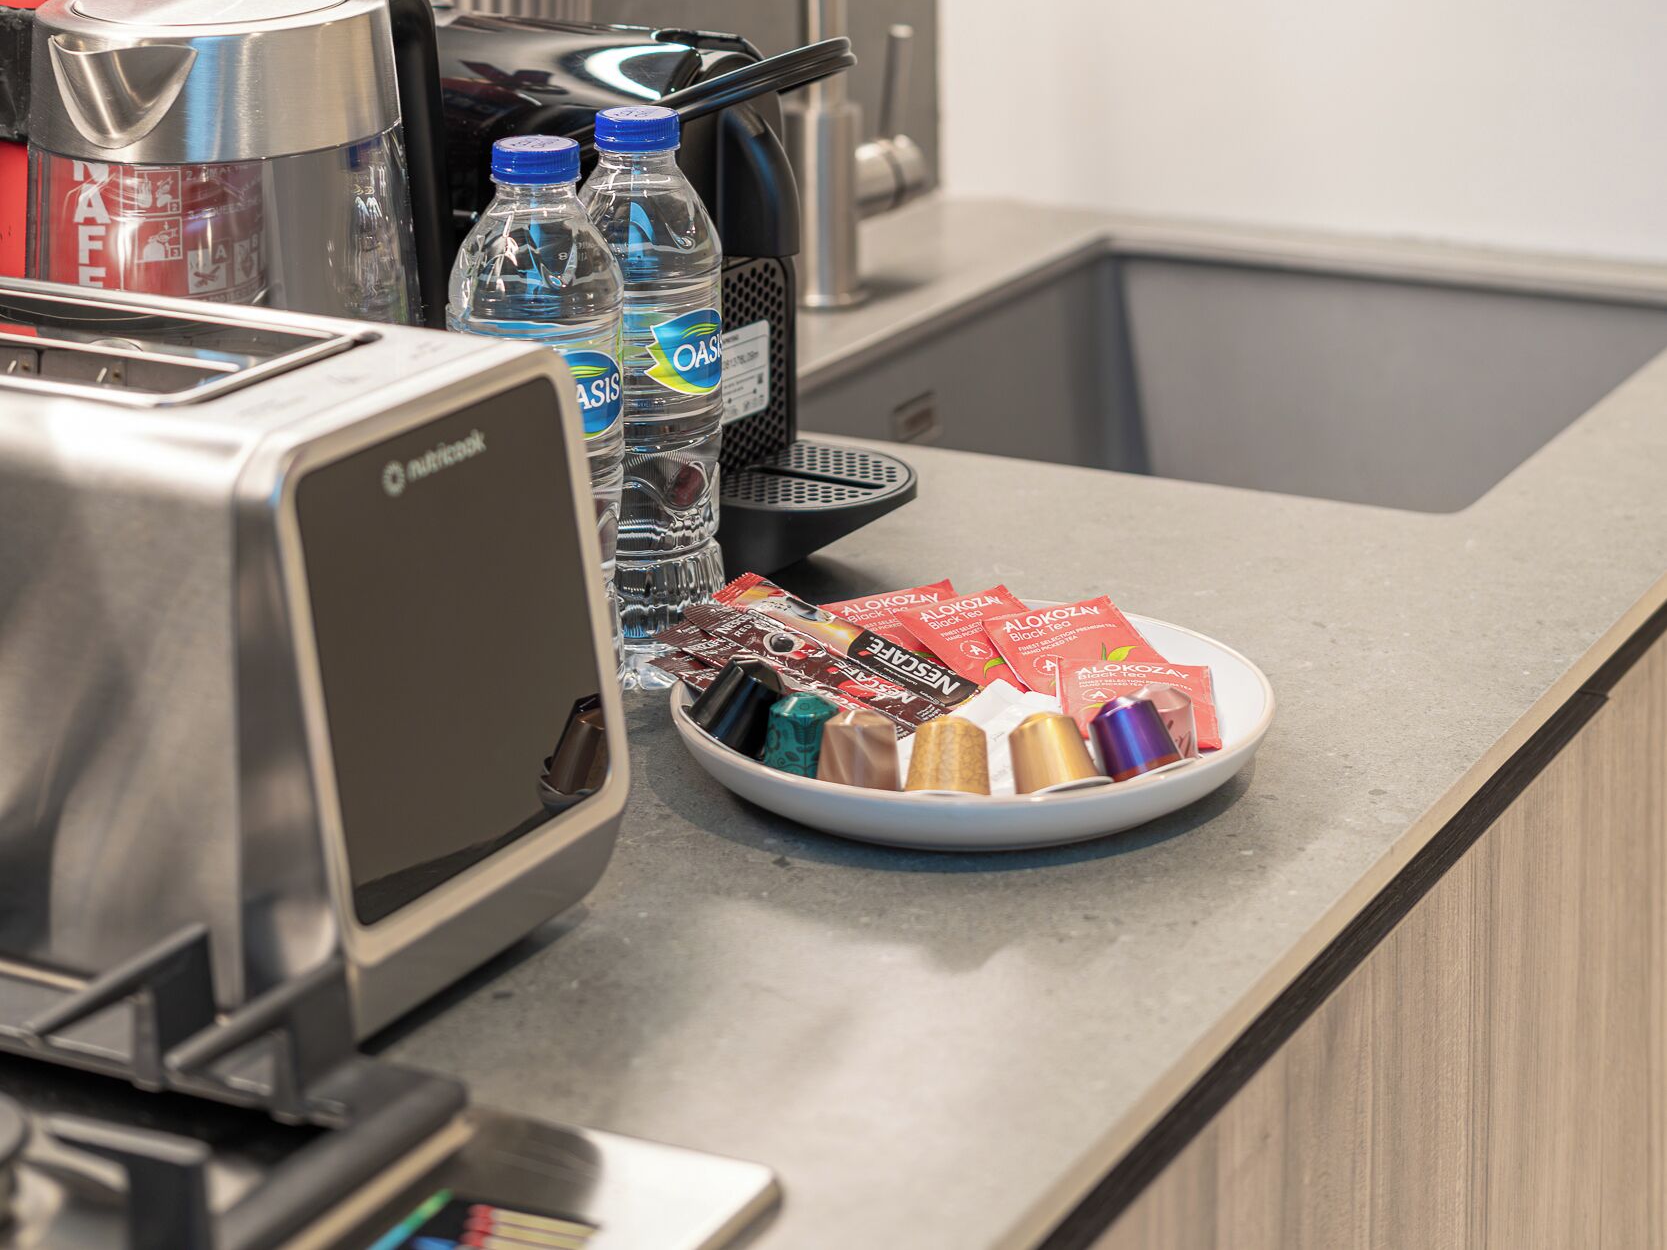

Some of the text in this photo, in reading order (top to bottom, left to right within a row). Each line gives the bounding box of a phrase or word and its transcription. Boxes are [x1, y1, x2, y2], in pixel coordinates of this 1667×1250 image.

[576, 372, 620, 410] ASIS
[406, 427, 487, 483] nutricook
[841, 593, 938, 616] ALOKOZAY
[920, 596, 1004, 623] ALOKOZAY
[847, 609, 885, 623] Black
[928, 616, 963, 630] Black
[960, 610, 984, 619] Tea
[1003, 606, 1100, 633] ALOKOZAY
[1009, 621, 1072, 642] Black Tea
[1018, 642, 1040, 651] FINEST
[1040, 630, 1077, 646] SELECTION
[1075, 664, 1189, 679] ALOKOZAY
[1079, 671, 1117, 680] Black
